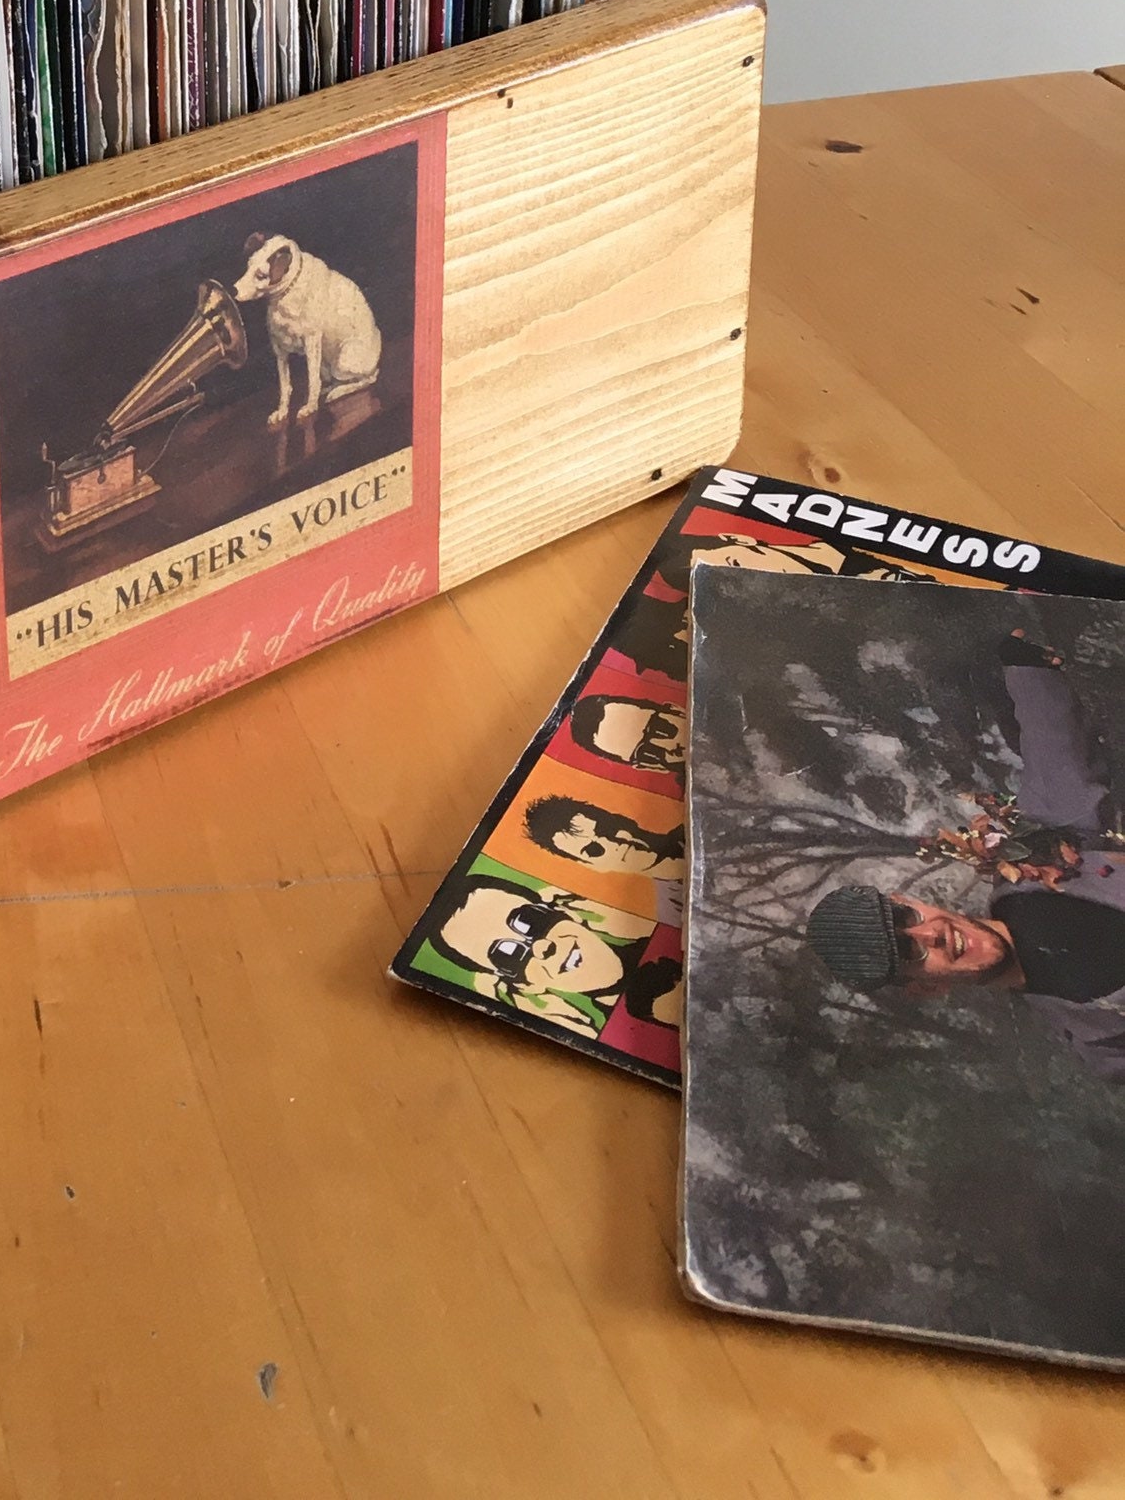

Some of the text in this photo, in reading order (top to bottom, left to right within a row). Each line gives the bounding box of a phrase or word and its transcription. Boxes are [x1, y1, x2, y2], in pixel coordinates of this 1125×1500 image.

[115, 522, 273, 615] MASTER'S
[701, 468, 1042, 573] MADNESS
[78, 629, 252, 742] Hallmark
[263, 607, 304, 666] of
[312, 561, 426, 633] Quality
